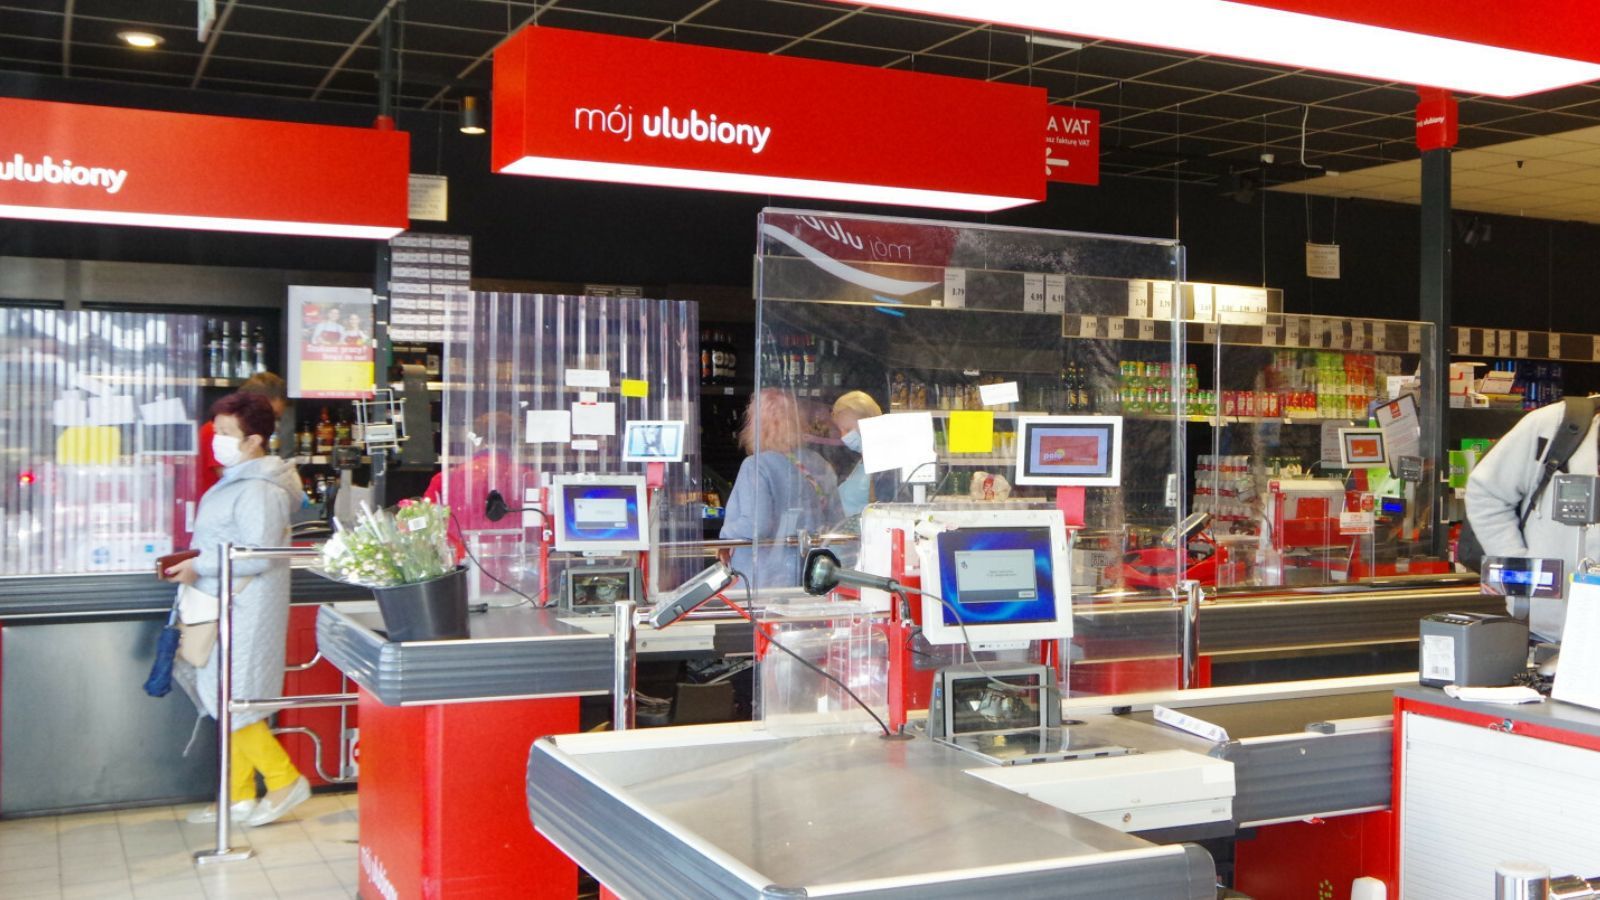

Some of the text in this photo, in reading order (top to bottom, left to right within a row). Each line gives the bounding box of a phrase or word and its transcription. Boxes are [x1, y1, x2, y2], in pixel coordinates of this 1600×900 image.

[575, 104, 771, 154] mój ulubiony
[1062, 117, 1091, 134] VAT
[0, 153, 128, 194] ulubiony
